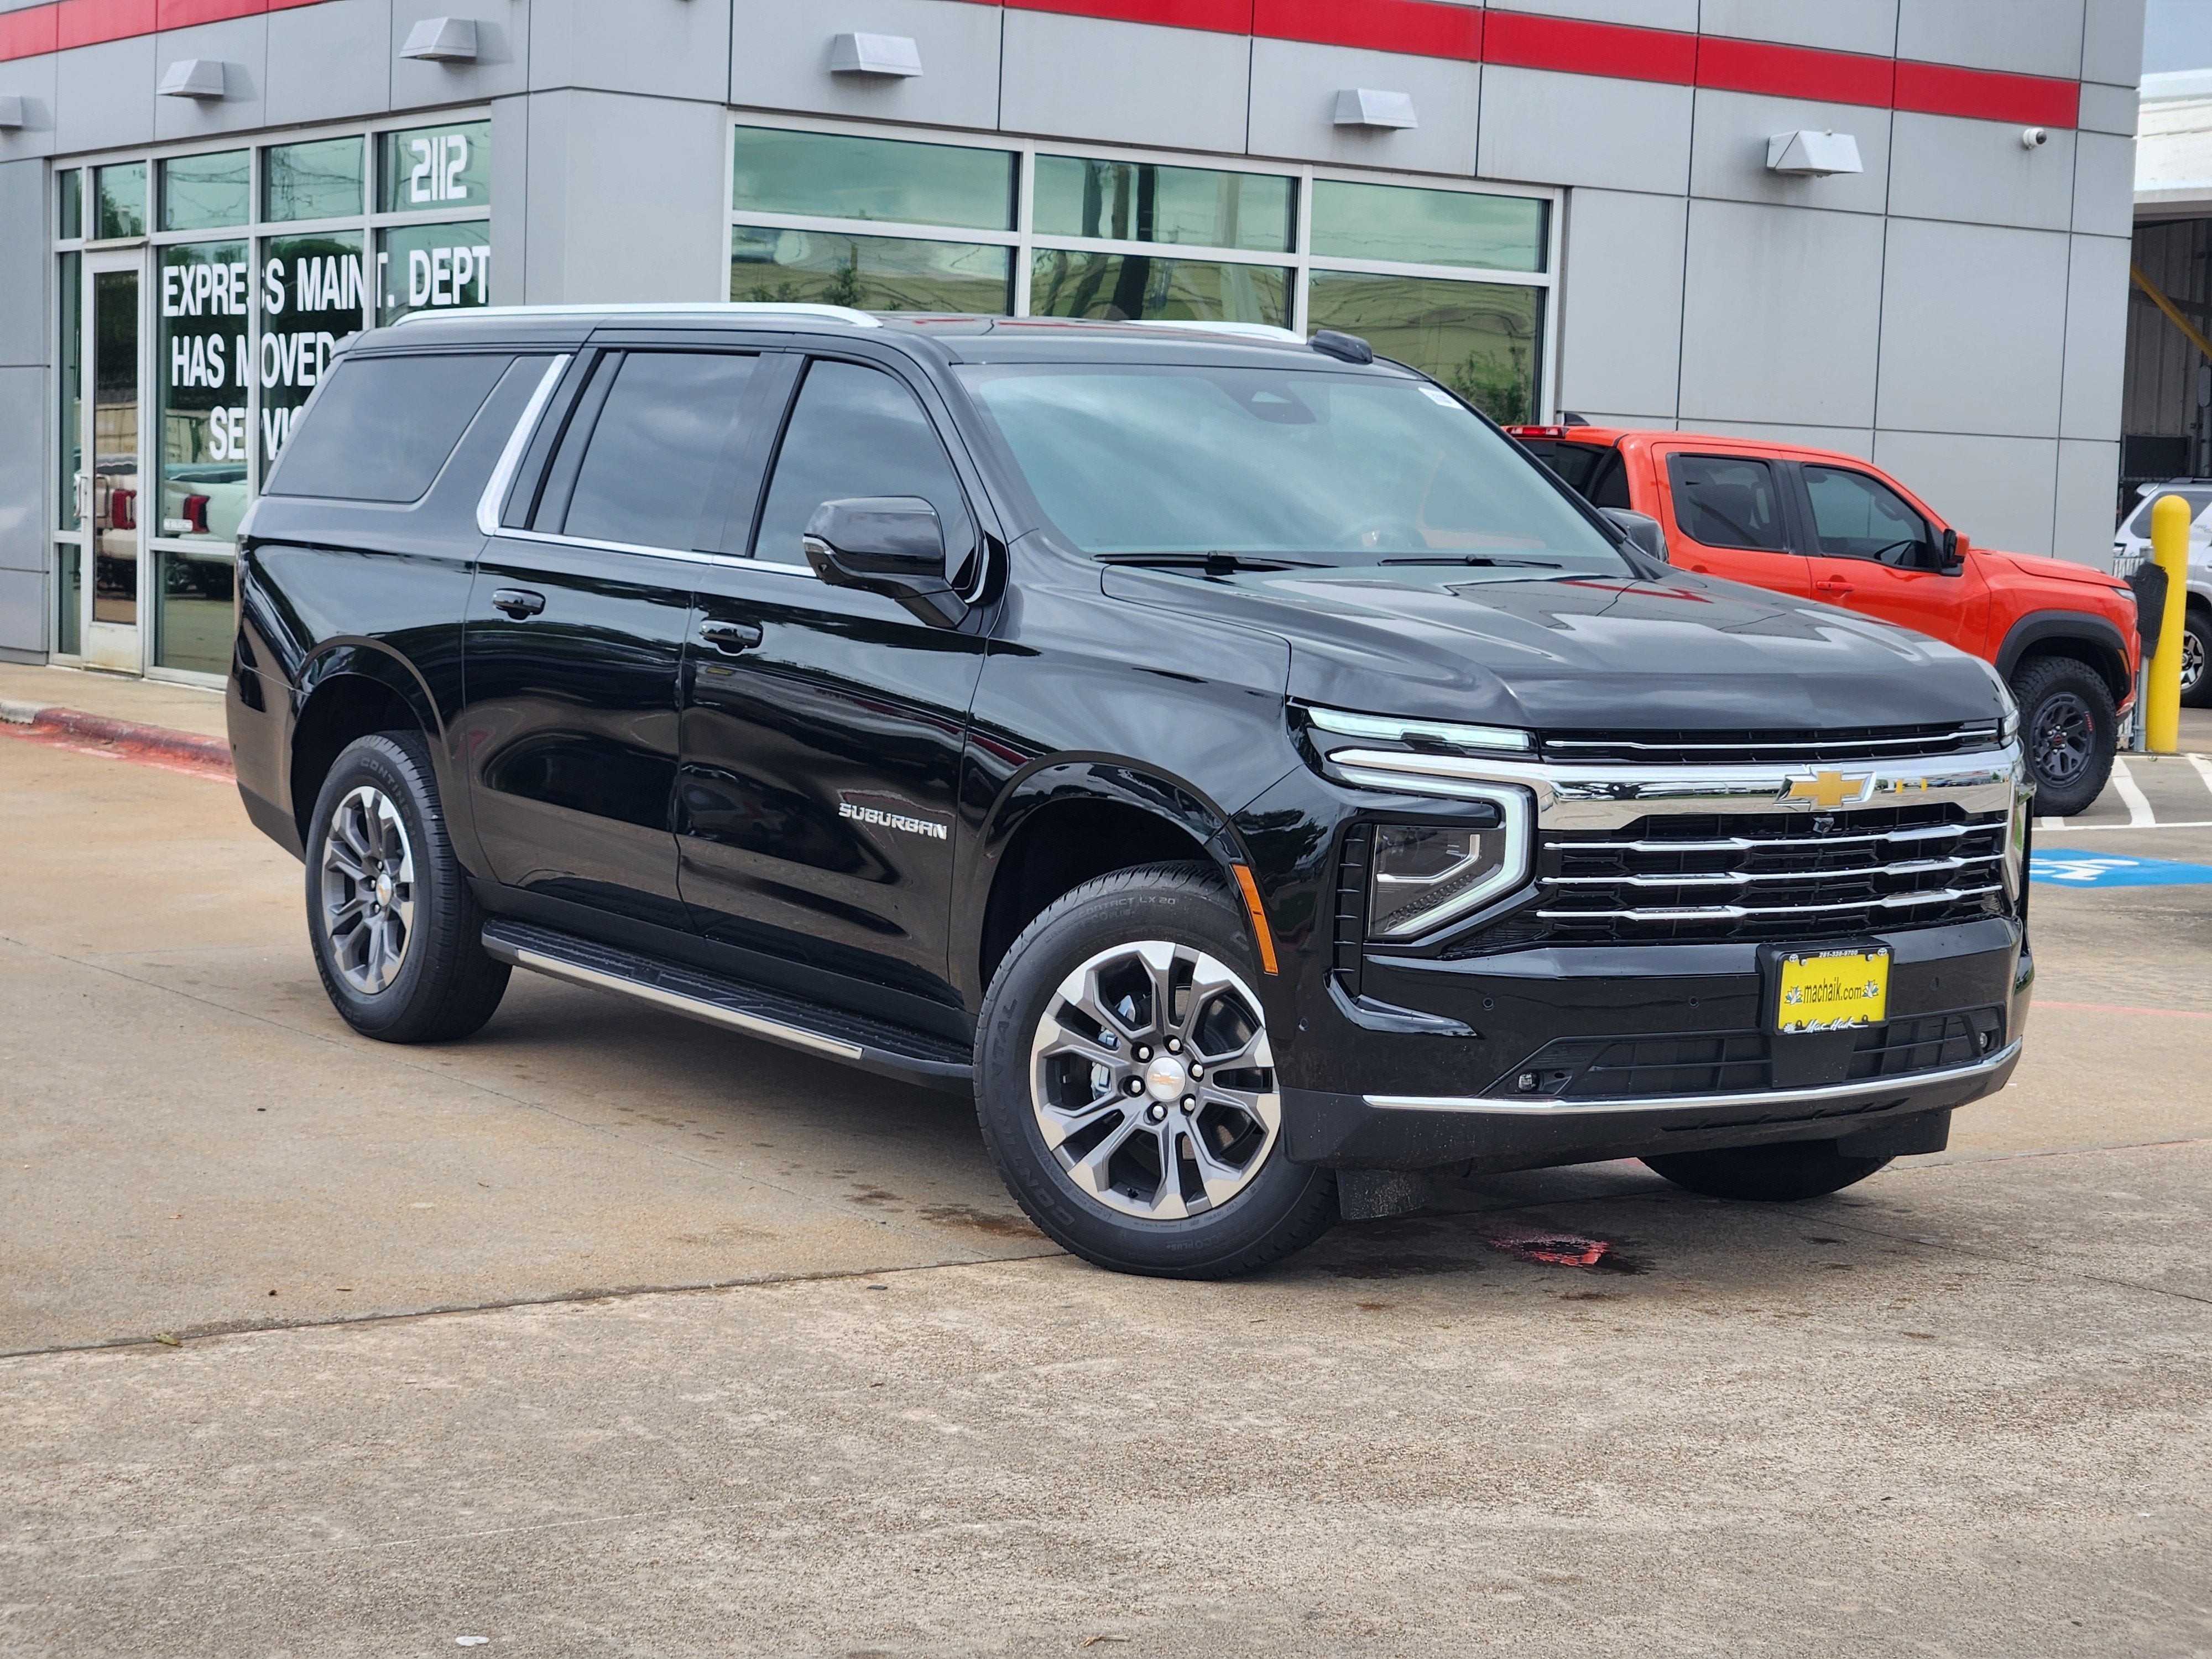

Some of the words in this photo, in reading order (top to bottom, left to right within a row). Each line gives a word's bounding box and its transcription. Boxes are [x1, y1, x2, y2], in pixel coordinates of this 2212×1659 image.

[163, 258, 285, 317] EXPRES
[409, 245, 491, 307] DEPT
[171, 333, 225, 389] HAS
[838, 802, 948, 840] SUBURBAN
[1803, 977, 1862, 1004] machaik.com
[1805, 1019, 1830, 1034] Mac
